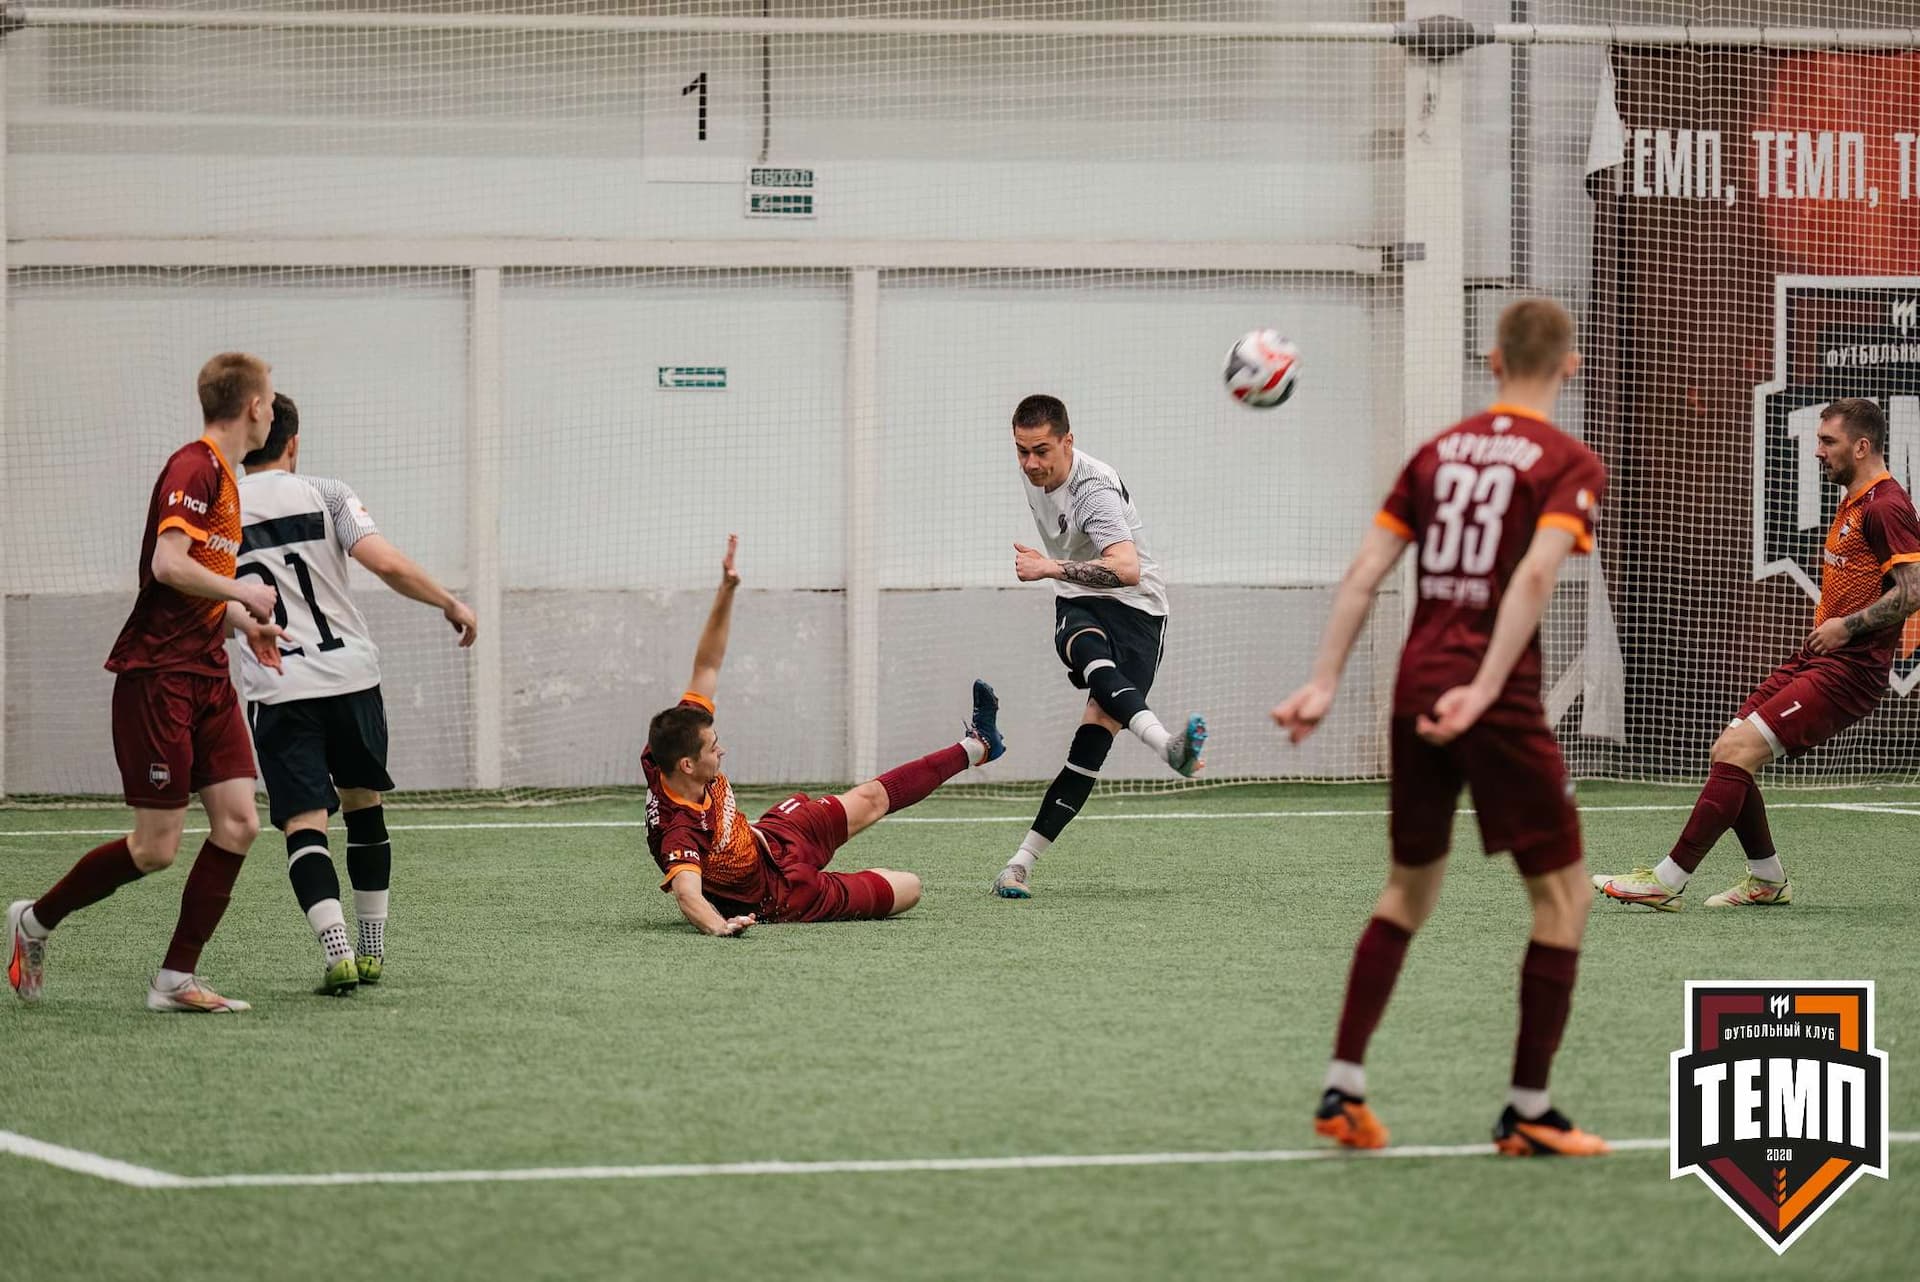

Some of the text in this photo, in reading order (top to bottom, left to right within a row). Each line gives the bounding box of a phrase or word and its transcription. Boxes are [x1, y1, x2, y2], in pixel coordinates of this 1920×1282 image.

[681, 72, 708, 141] 1
[1752, 130, 1879, 208] ТЕМП,
[183, 495, 208, 515] ПСБ
[1420, 462, 1516, 575] 33
[1780, 700, 1802, 718] 1
[778, 798, 801, 815] 11
